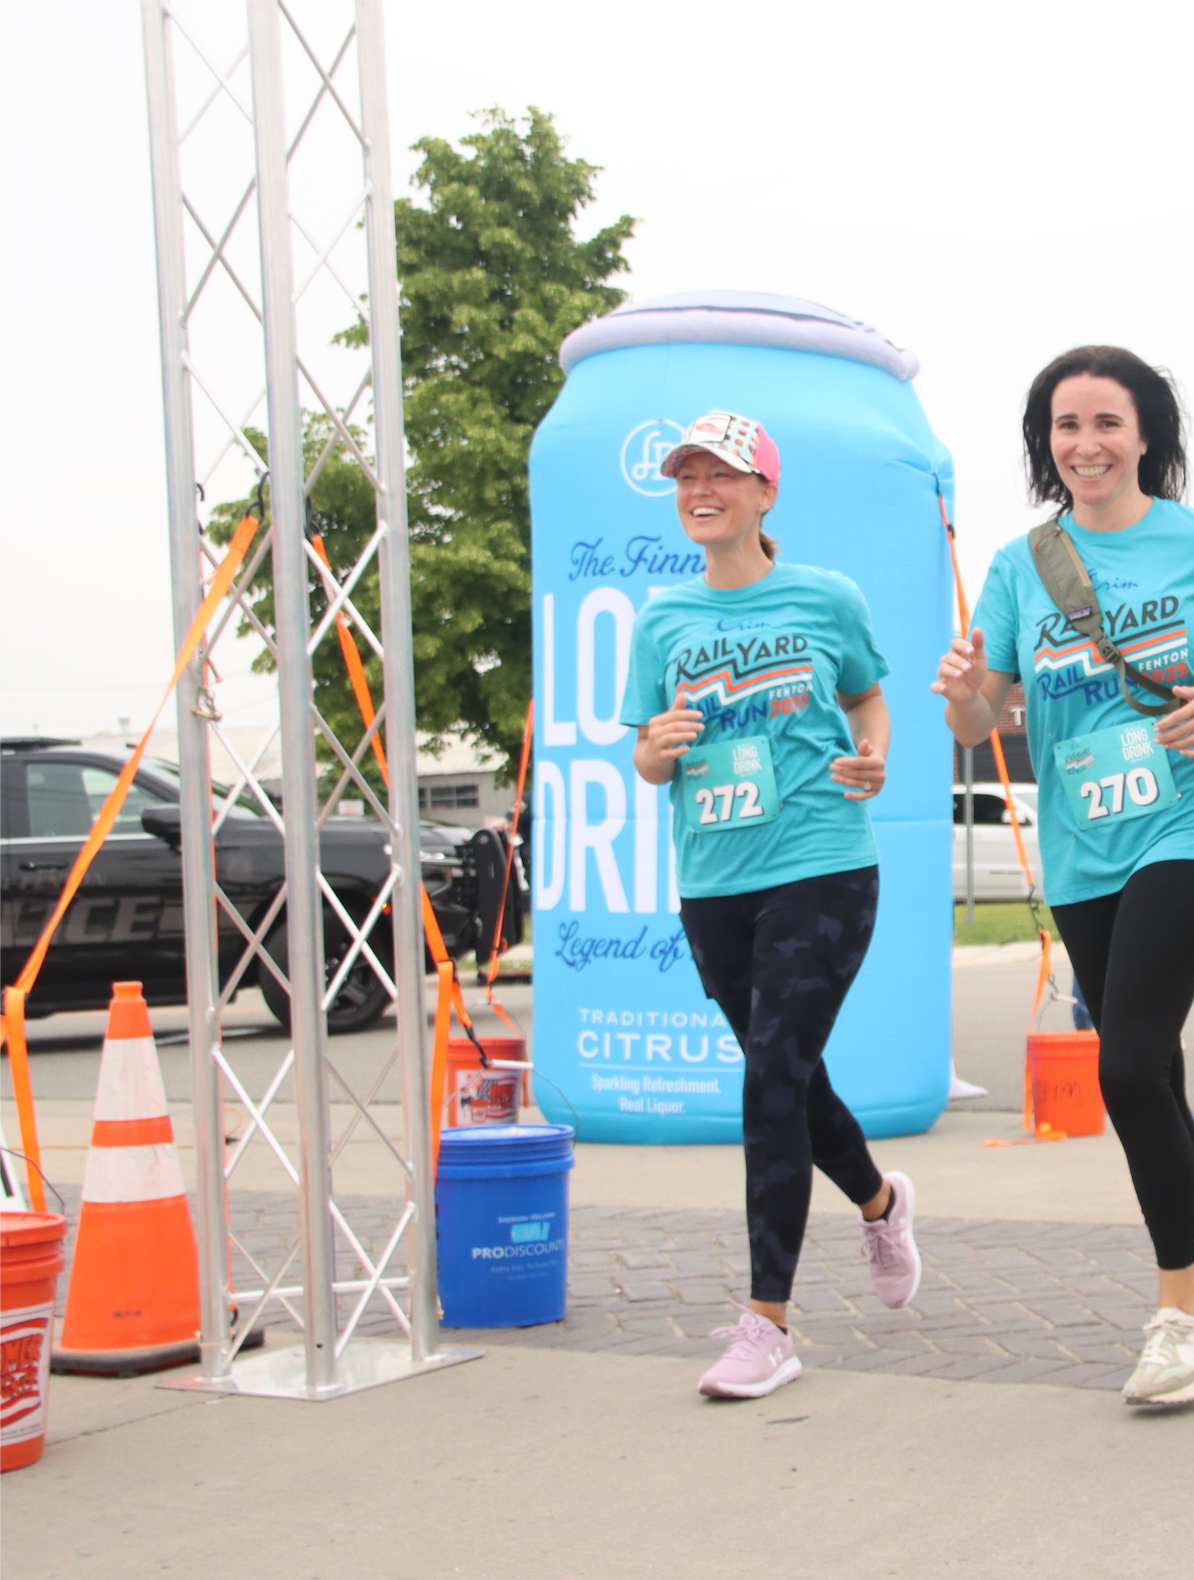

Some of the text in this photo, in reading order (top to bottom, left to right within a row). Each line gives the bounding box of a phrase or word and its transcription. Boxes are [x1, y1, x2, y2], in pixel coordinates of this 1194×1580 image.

[569, 535, 708, 581] The Finn
[1034, 595, 1179, 651] RAYARD
[543, 586, 672, 747] LO
[674, 635, 808, 686] RAILYARD
[1139, 649, 1188, 672] FENTON
[1036, 666, 1085, 701] RAIL
[686, 696, 721, 717] AIL
[719, 701, 768, 732] RUN
[769, 693, 810, 718] 2025
[732, 745, 759, 761] LONG
[1120, 728, 1149, 747] LONG
[1122, 741, 1155, 761] DRINK
[733, 757, 763, 774] DRINK
[695, 781, 764, 825] 272
[1080, 767, 1160, 820] 270
[535, 758, 682, 914] DRI
[556, 920, 687, 973] Legend of
[579, 1008, 727, 1029] TRADITIONA
[577, 1030, 746, 1063] CITRUS
[591, 1072, 722, 1095] Sparkling Refreshment.
[618, 1095, 686, 1117] Real Liquor.
